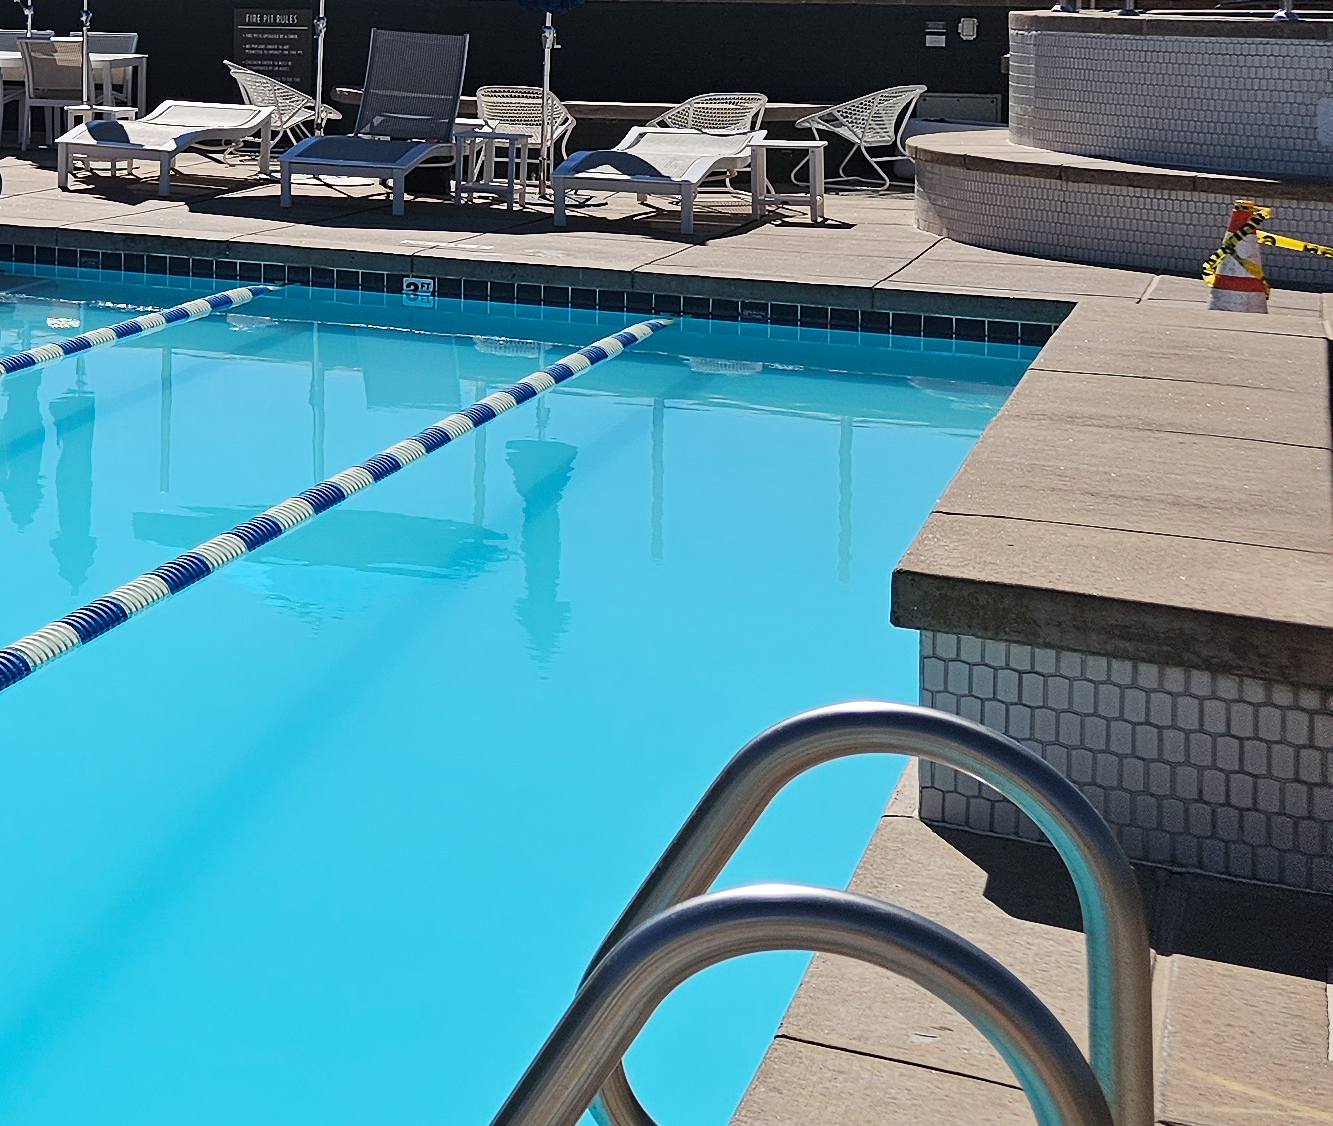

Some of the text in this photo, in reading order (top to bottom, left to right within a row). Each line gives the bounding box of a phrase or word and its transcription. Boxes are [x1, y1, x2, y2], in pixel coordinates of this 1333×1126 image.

[246, 14, 298, 24] FIRE PIT RULES
[420, 282, 430, 290] FT
